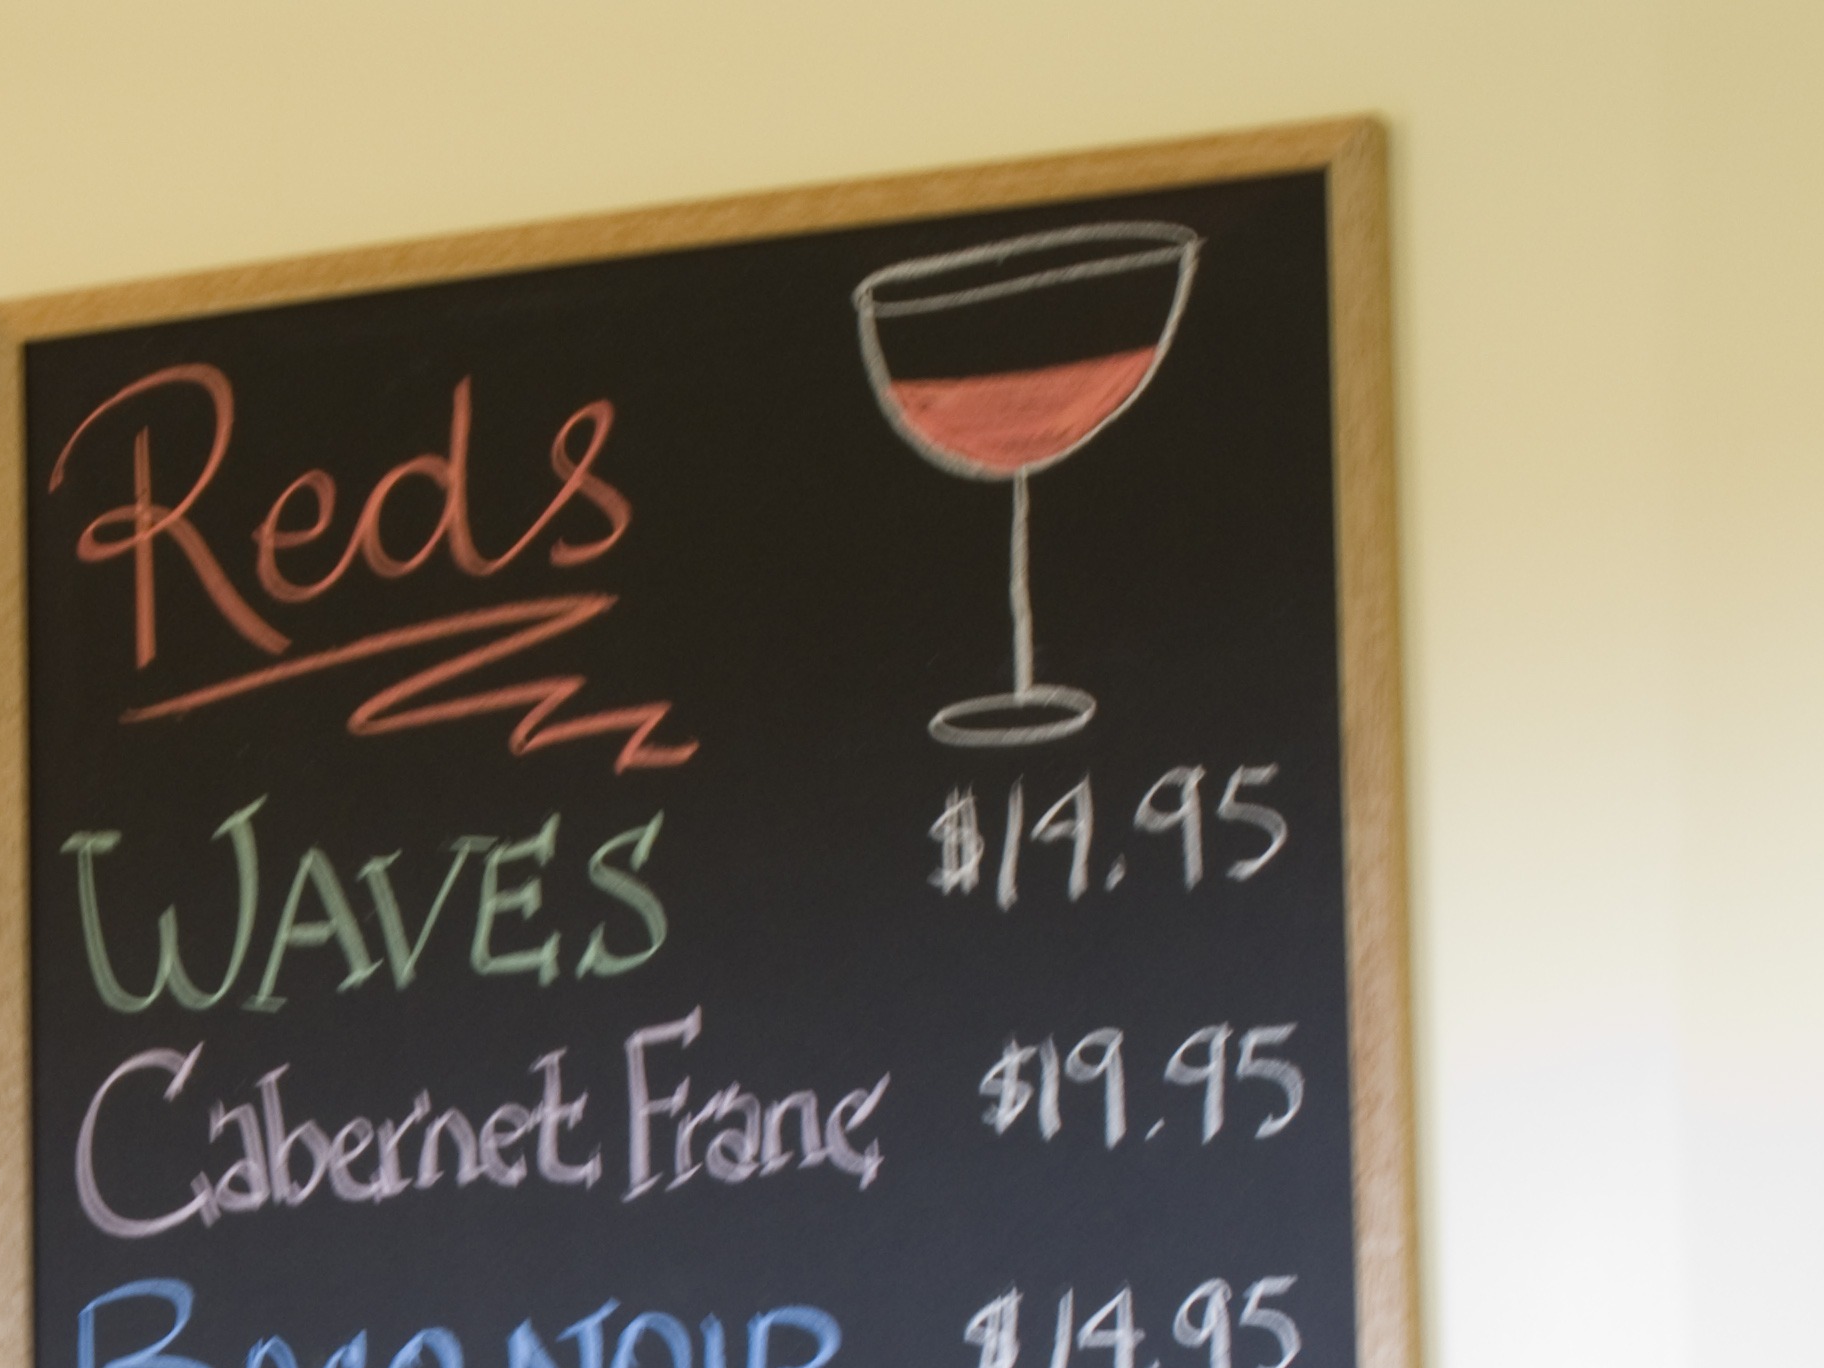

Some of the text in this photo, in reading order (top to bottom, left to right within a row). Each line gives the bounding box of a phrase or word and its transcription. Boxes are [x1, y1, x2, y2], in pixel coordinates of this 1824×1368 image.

[48, 363, 633, 669] Reds
[59, 765, 1289, 1015] WAVES $14.95
[75, 1006, 1307, 1239] Cabernet Franc $19.95
